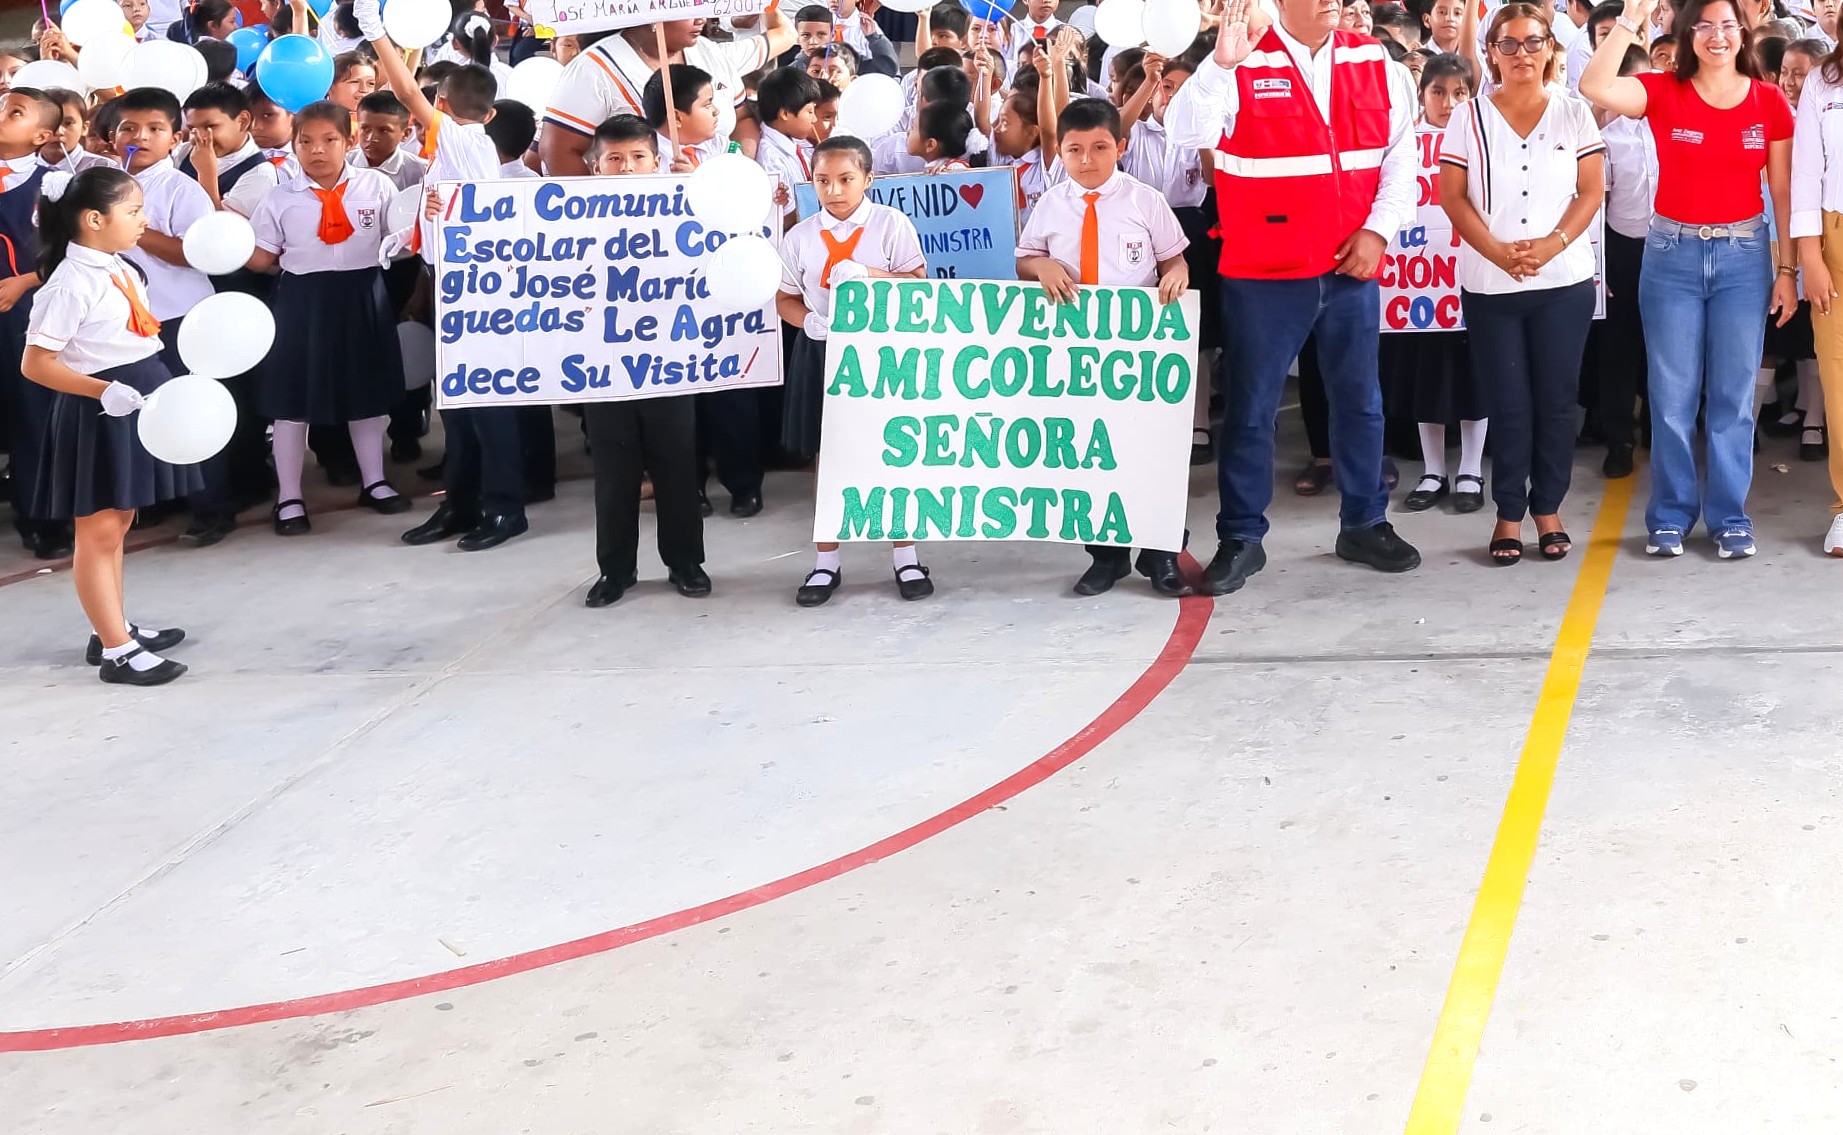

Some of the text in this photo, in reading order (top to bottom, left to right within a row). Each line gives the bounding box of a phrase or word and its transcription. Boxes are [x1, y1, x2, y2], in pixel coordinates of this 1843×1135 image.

[918, 227, 993, 254] INISTRA
[441, 264, 502, 304] gio
[603, 305, 658, 344] Le
[830, 280, 1191, 341] BIENVENIDA
[1385, 295, 1465, 330] COC
[441, 364, 541, 397] dece
[560, 354, 612, 393] Su
[952, 344, 1192, 404] COLEGIO
[881, 411, 1118, 471] SEÑORA
[836, 485, 1133, 544] MINISTRA
